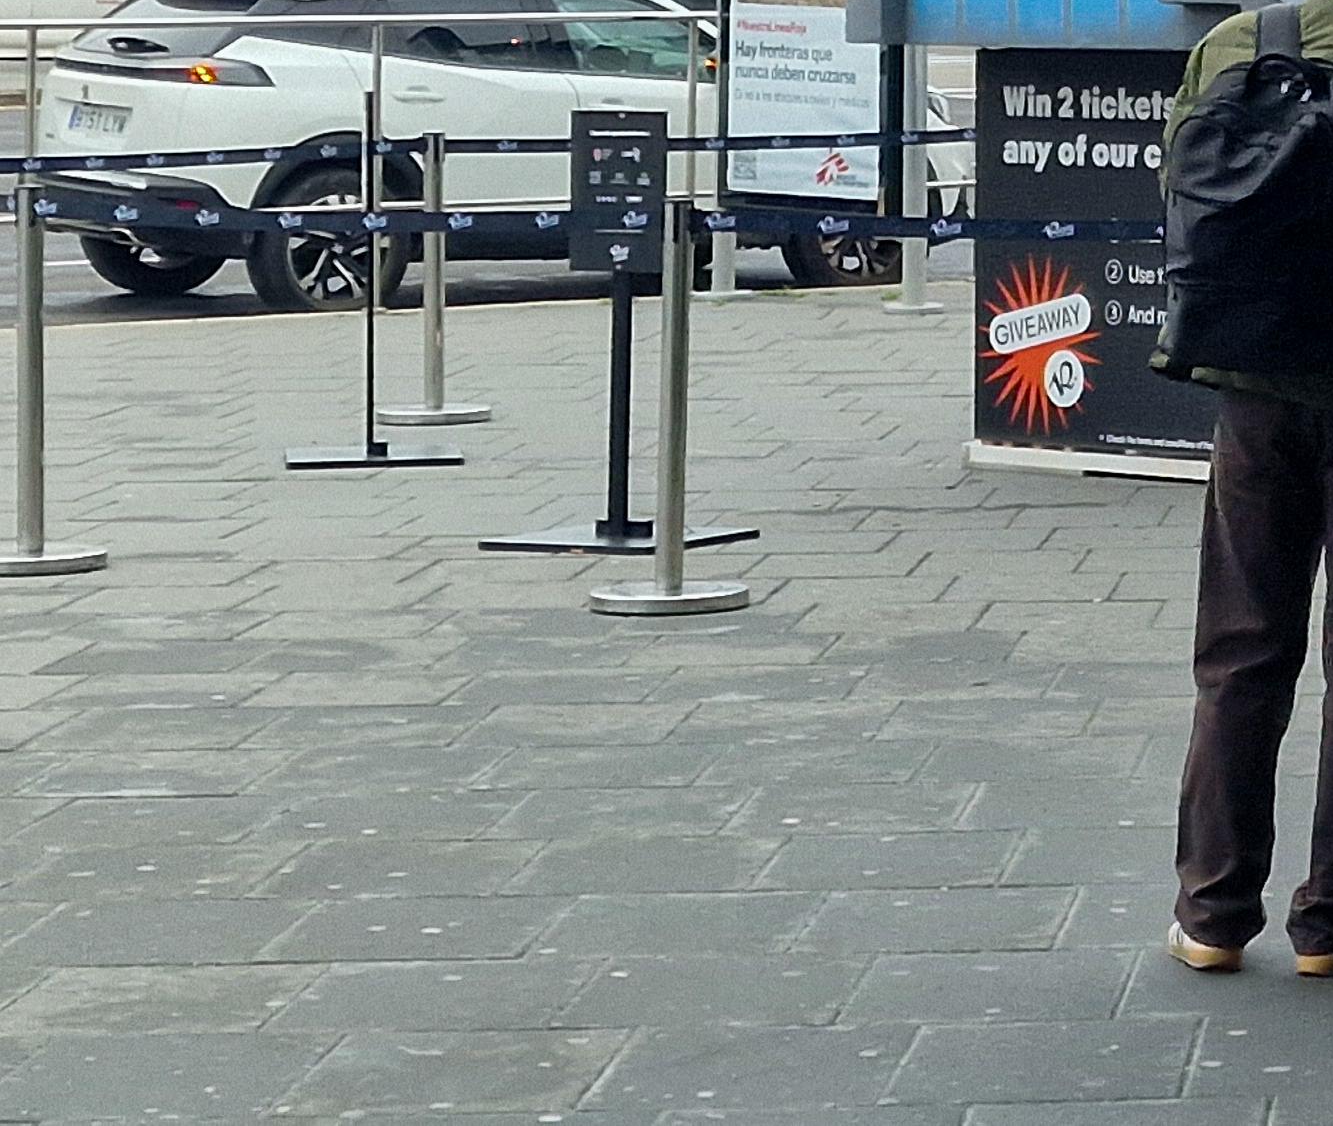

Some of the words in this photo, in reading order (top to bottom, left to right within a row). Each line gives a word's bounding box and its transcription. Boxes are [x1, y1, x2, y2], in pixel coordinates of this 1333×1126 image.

[736, 40, 757, 60] Hay
[759, 41, 809, 60] fronteras
[811, 49, 833, 63] que
[735, 66, 769, 80] nunca
[771, 64, 805, 81] deben
[807, 70, 857, 85] cruzarse
[1003, 84, 1052, 118] Win
[1057, 86, 1074, 118] 2
[1080, 85, 1175, 121] tickets
[1002, 140, 1053, 173] any
[1057, 133, 1088, 167] of
[1092, 143, 1139, 169] our
[1128, 265, 1155, 284] Use
[994, 303, 1080, 346] GIVEAWAY
[1128, 305, 1155, 324] And
